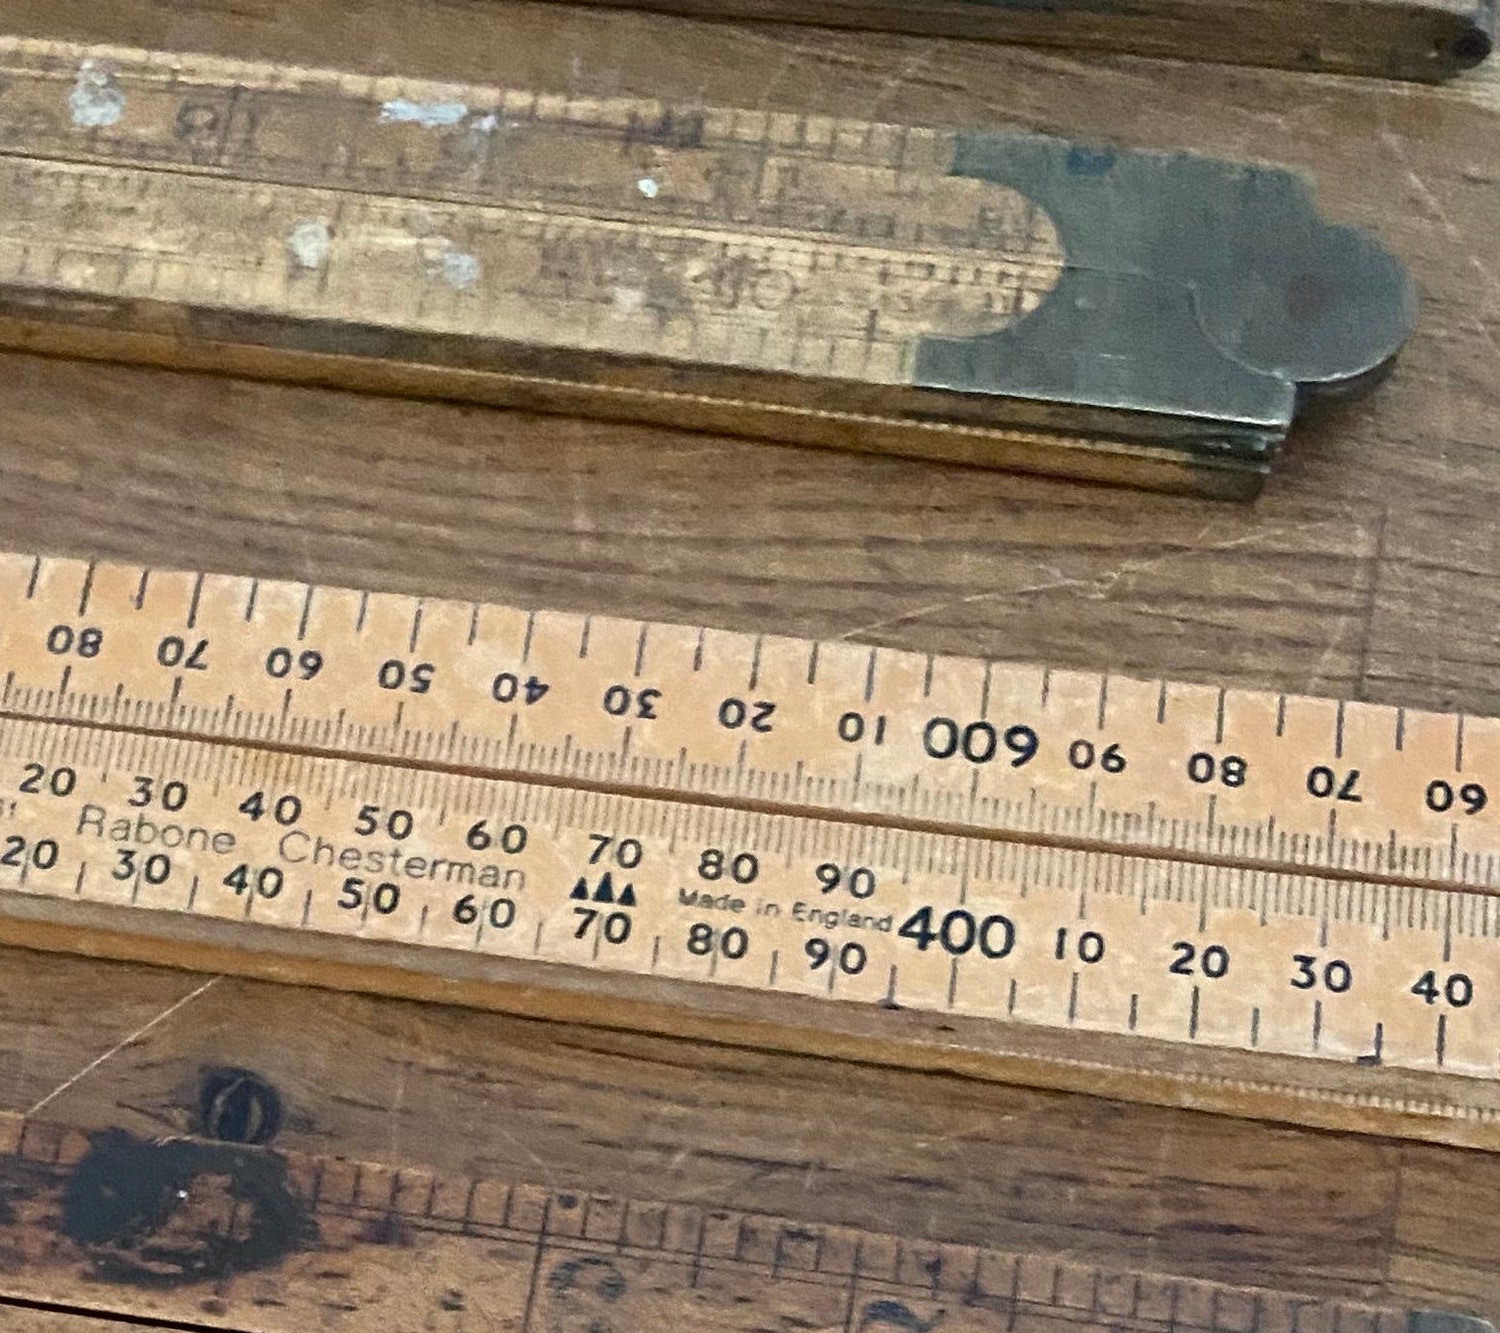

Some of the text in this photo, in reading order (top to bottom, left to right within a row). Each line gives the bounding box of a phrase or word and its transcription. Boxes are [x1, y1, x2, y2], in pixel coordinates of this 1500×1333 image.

[47, 624, 103, 658] 80
[157, 636, 210, 671] 70
[266, 646, 324, 681] 60
[378, 659, 437, 694] 50
[492, 672, 550, 706] 40
[602, 684, 663, 720] 30
[718, 697, 777, 733] 20
[838, 711, 887, 746] 10
[923, 716, 1039, 768] 600
[1068, 739, 1127, 773] 90
[1186, 752, 1248, 788] 80
[1306, 765, 1363, 802] 70
[1425, 779, 1488, 815] 60
[19, 762, 77, 797] 20
[127, 776, 189, 812] 30
[238, 791, 302, 825] 40
[354, 804, 414, 840] 50
[466, 819, 528, 855] 60
[587, 833, 643, 869] 70
[697, 849, 760, 885] 80
[814, 863, 876, 899] 90
[76, 804, 527, 892] Rabone Chesterman
[0, 835, 60, 870] 20
[111, 849, 171, 885] 30
[222, 865, 284, 900] 40
[337, 880, 400, 915] 50
[452, 894, 516, 929] 60
[572, 907, 632, 944] 70
[686, 923, 749, 960] 80
[804, 938, 868, 976] 90
[898, 905, 1016, 959] 400
[1054, 926, 1106, 964] 10
[1169, 941, 1230, 979] 20
[1289, 954, 1352, 994] 30
[1410, 970, 1474, 1008] 40
[678, 887, 893, 934] Made in England
